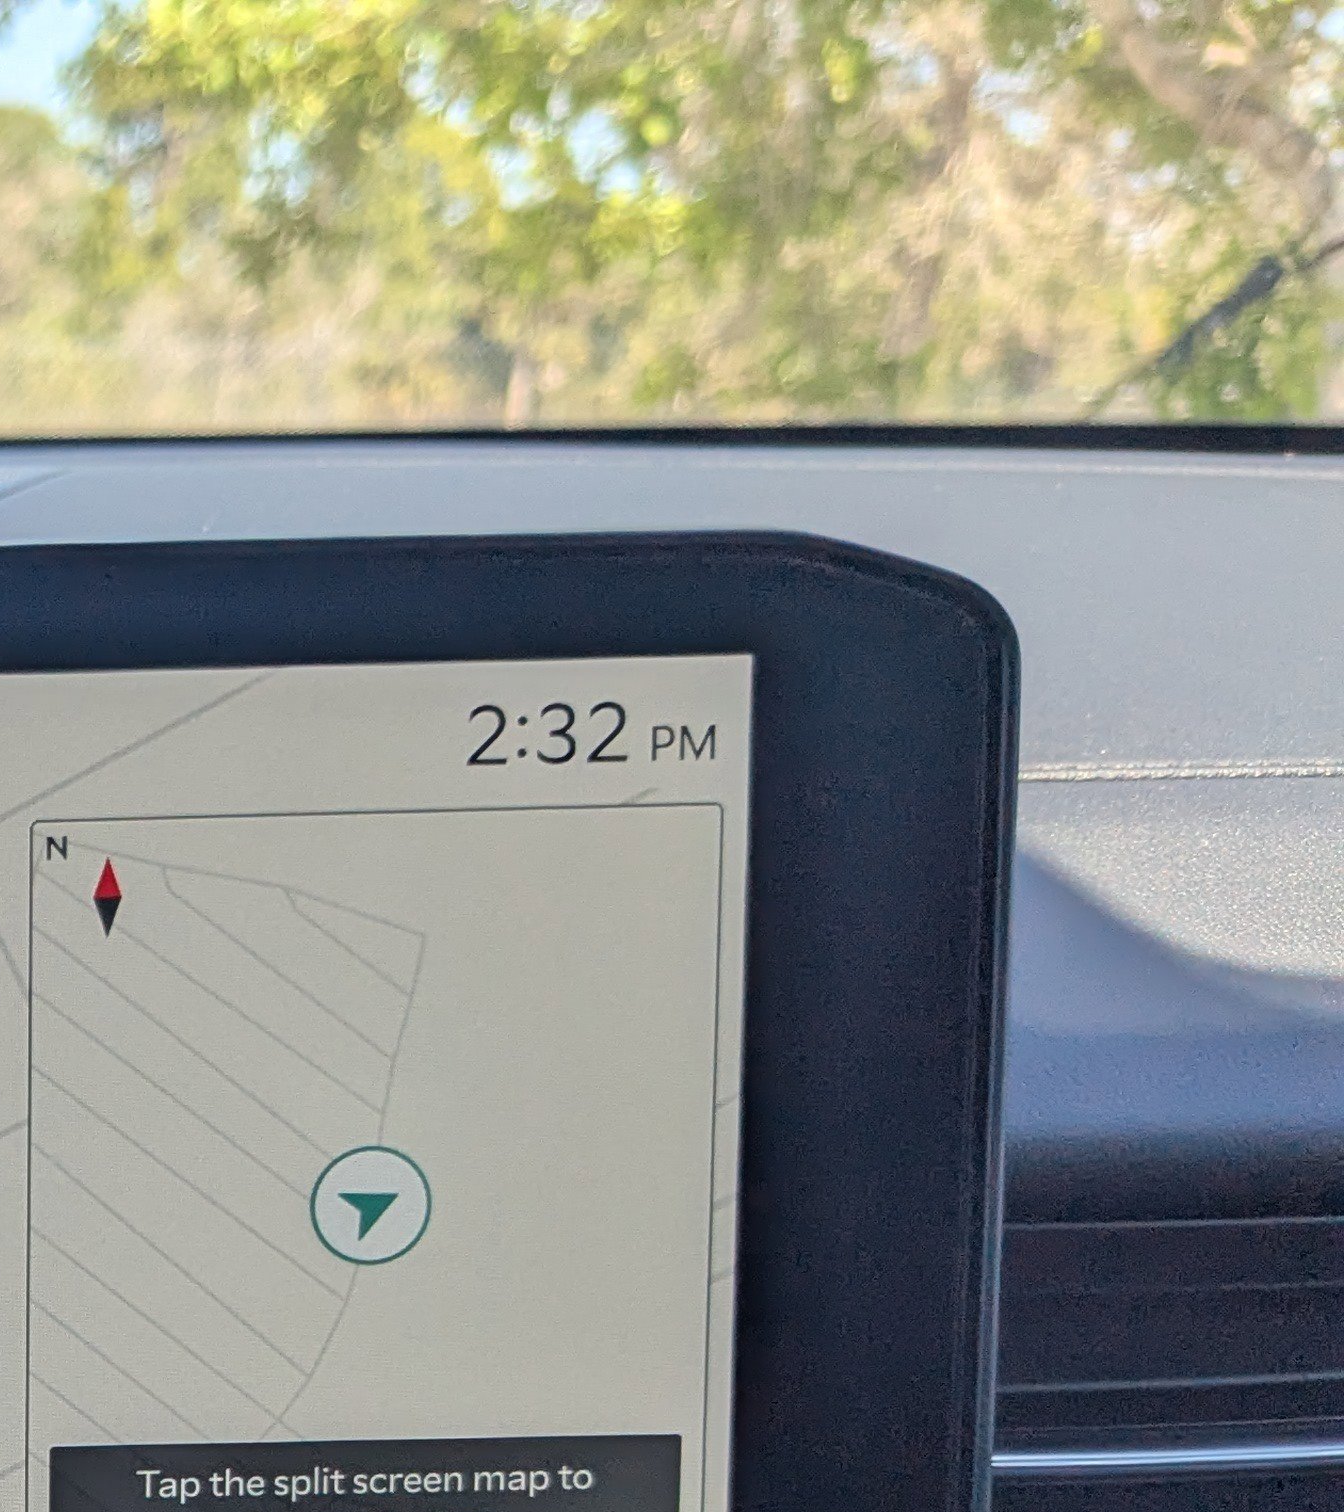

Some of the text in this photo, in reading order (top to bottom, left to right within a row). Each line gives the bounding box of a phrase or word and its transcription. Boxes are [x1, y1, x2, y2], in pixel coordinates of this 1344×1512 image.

[466, 701, 718, 767] 2:32 PM
[45, 836, 69, 861] N
[136, 1464, 594, 1504] Tap the split screen map to
